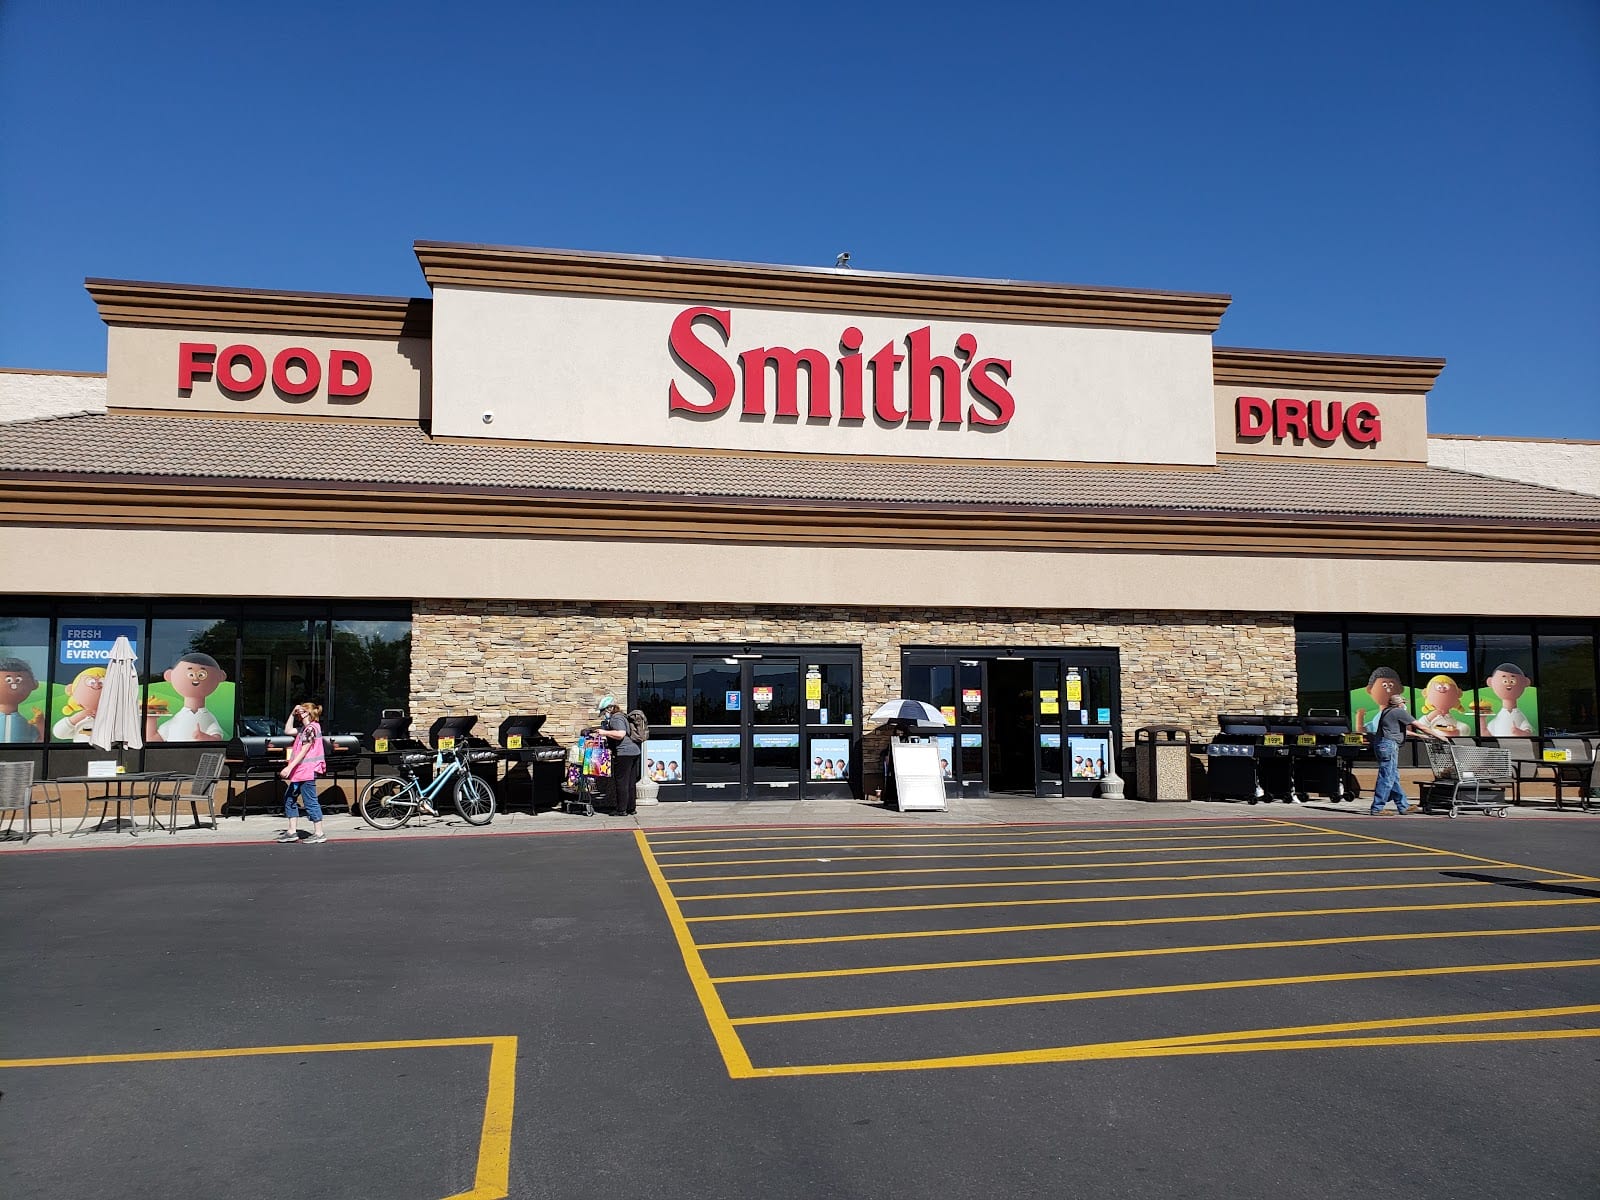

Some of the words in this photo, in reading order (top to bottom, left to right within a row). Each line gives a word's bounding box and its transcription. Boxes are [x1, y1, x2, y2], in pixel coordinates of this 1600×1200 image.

[178, 342, 373, 398] FOOD
[669, 306, 1015, 428] Smith's
[1236, 396, 1382, 445] DRUG
[67, 629, 102, 639] FRESH
[66, 640, 90, 649] FOR
[66, 650, 110, 659] EVERYO
[1420, 652, 1436, 661] FOR
